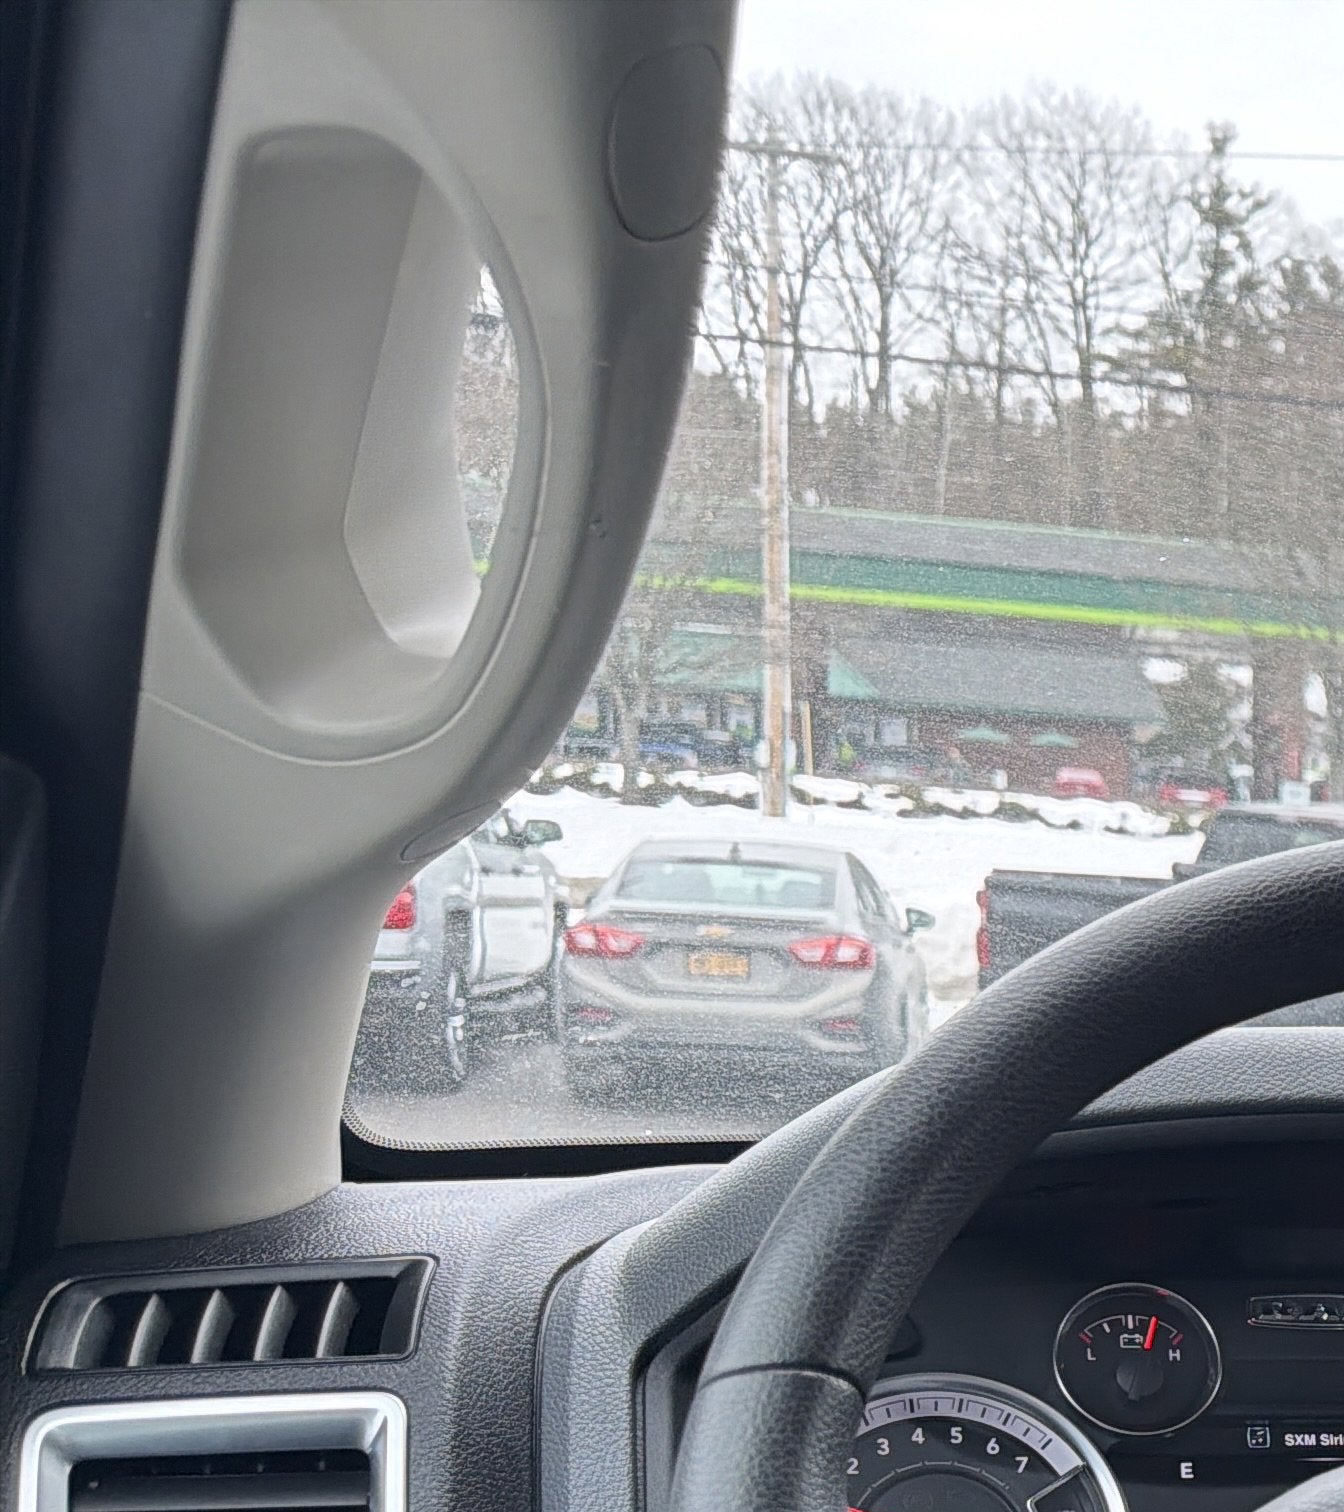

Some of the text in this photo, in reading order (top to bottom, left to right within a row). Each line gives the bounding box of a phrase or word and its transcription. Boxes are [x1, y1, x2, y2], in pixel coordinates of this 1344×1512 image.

[1086, 1348, 1097, 1361] L
[1168, 1348, 1182, 1361] H
[911, 1427, 925, 1444] 4
[949, 1427, 963, 1444] 5
[1284, 1433, 1316, 1446] SXM
[876, 1438, 890, 1455] 3
[986, 1437, 1000, 1455] 6
[846, 1458, 859, 1475] 2
[1014, 1456, 1029, 1474] 7
[1180, 1462, 1194, 1479] E
